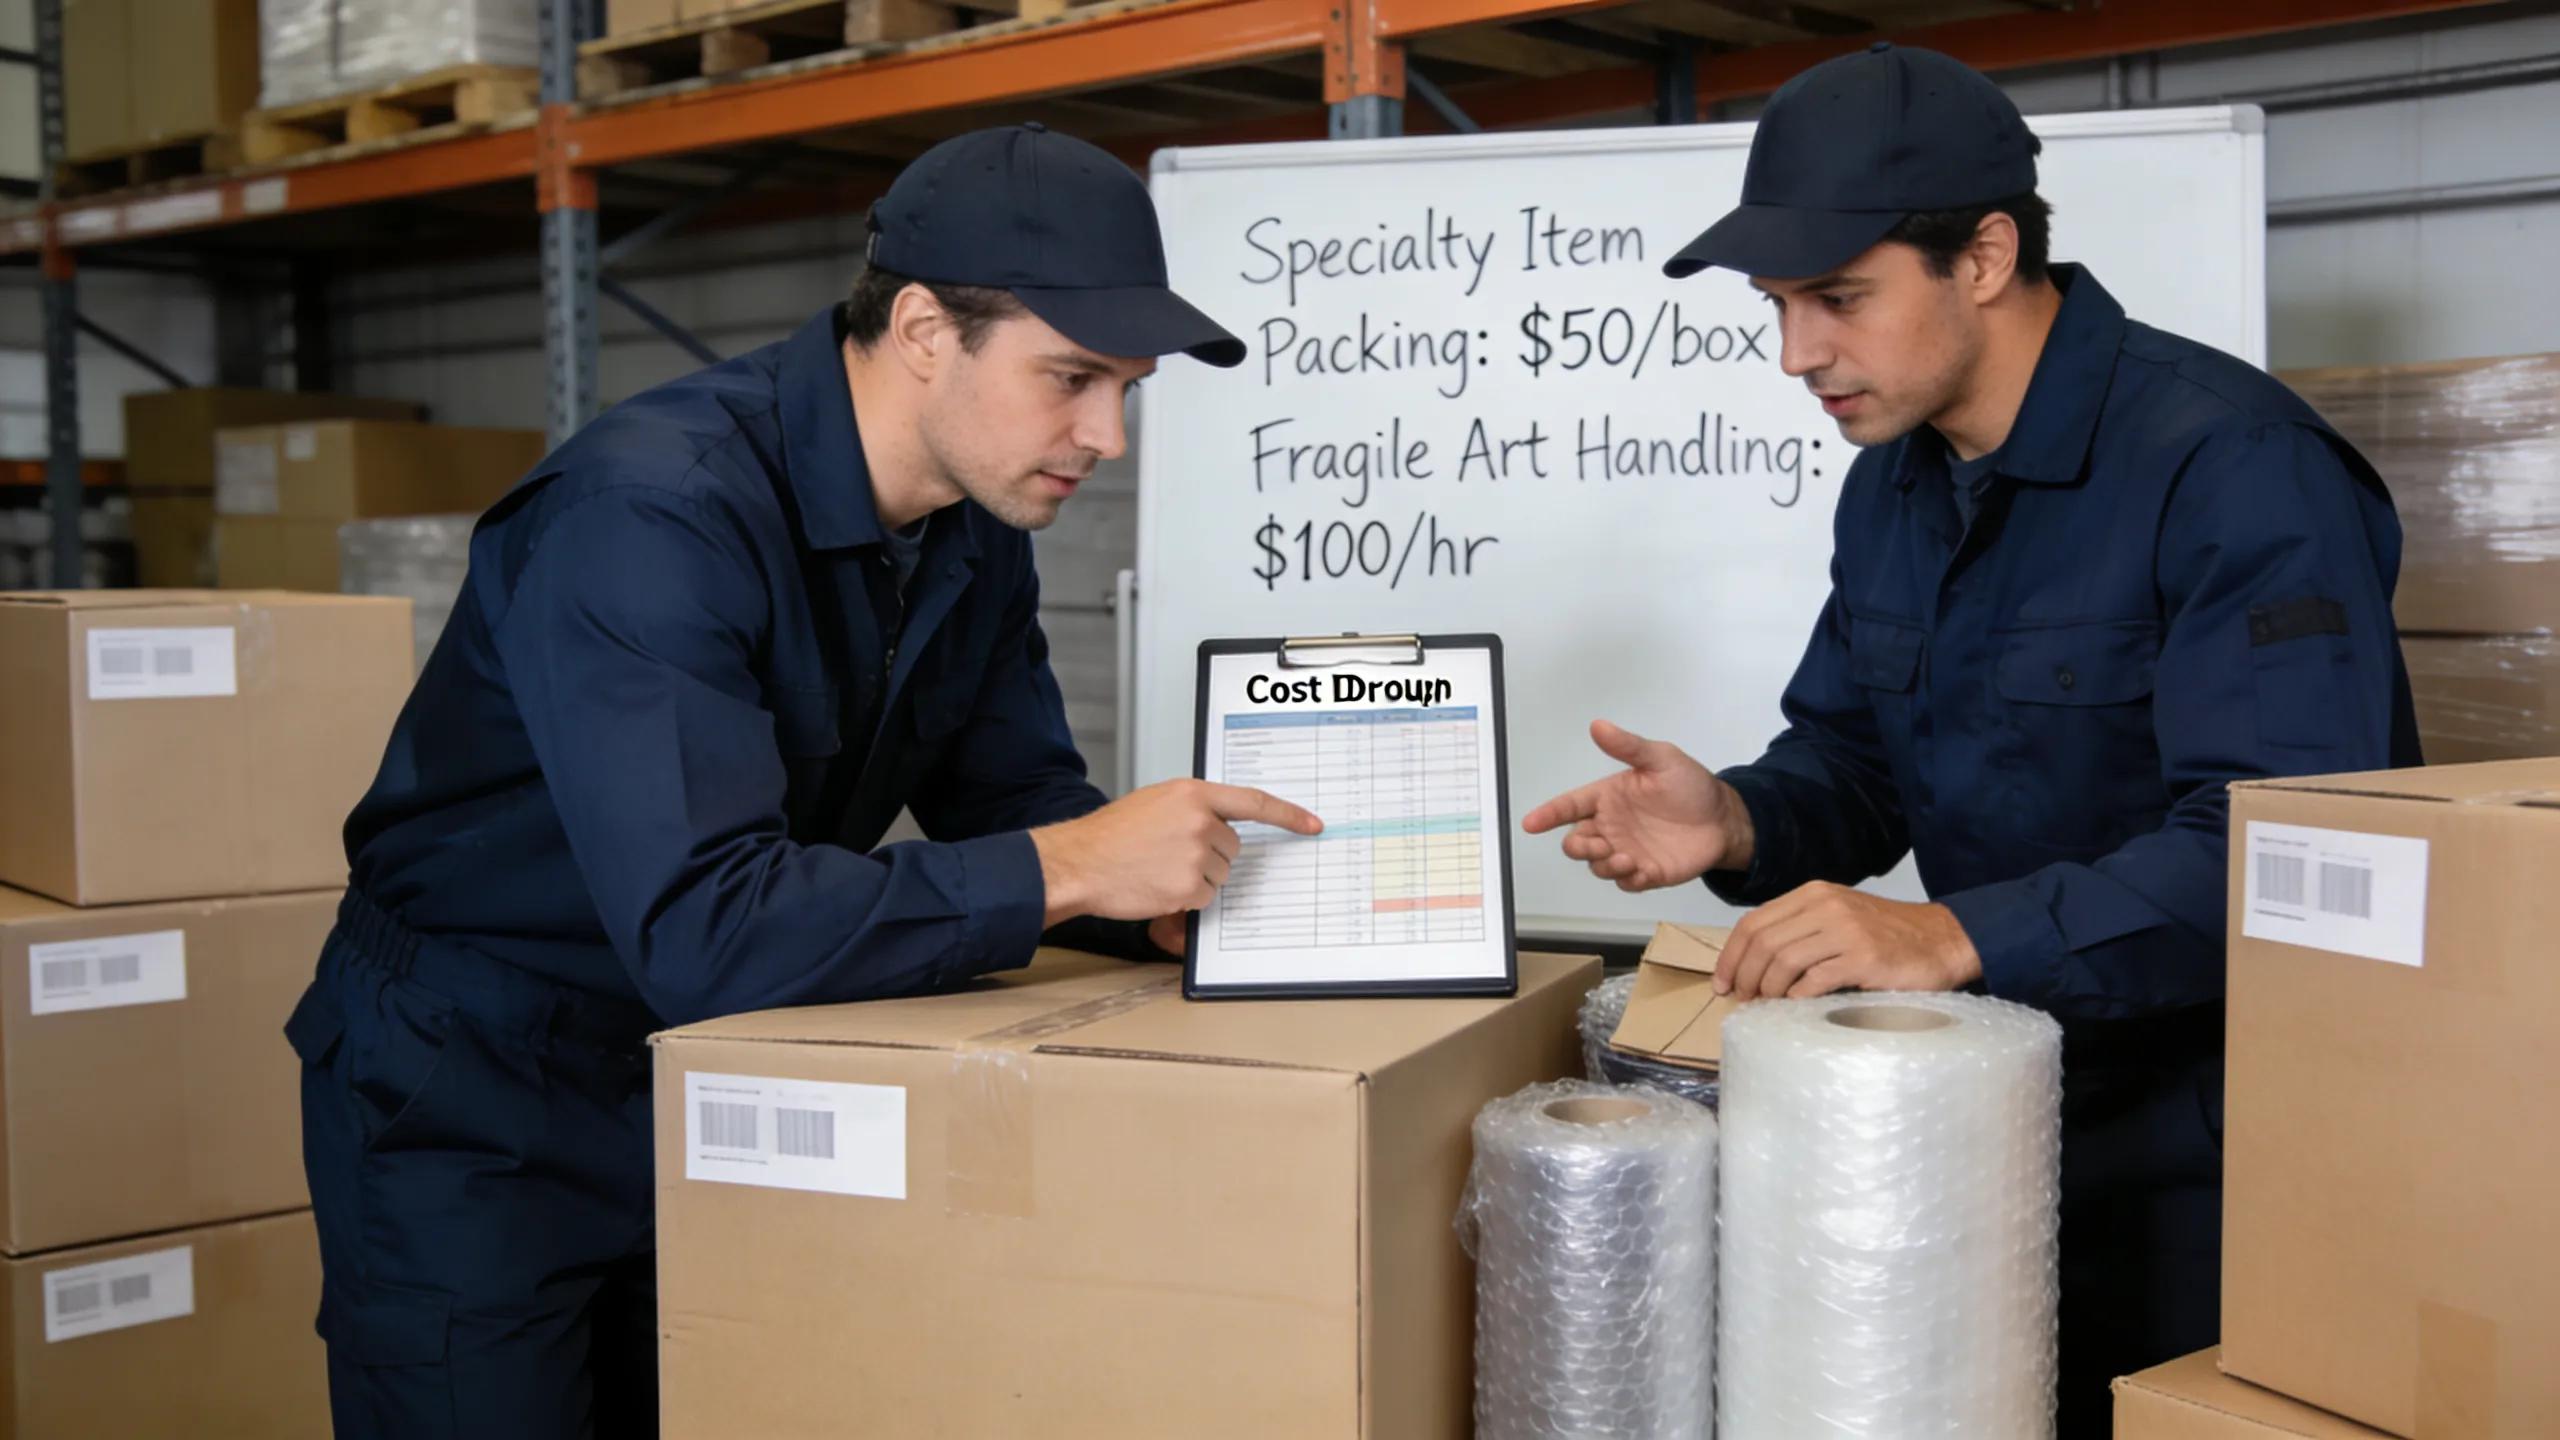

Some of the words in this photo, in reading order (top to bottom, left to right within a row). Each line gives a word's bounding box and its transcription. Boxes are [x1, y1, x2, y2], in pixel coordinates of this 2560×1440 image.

[1240, 207, 1496, 306] Specialty
[1520, 206, 1644, 272] Item
[1258, 312, 1490, 399] Packing:
[1518, 300, 1770, 379] $50/box
[1249, 417, 1434, 508] Fragile
[1458, 417, 1550, 482] Art
[1576, 411, 1825, 508] Handling:
[1252, 511, 1500, 592] $100/hr
[1246, 674, 1323, 704] Cost
